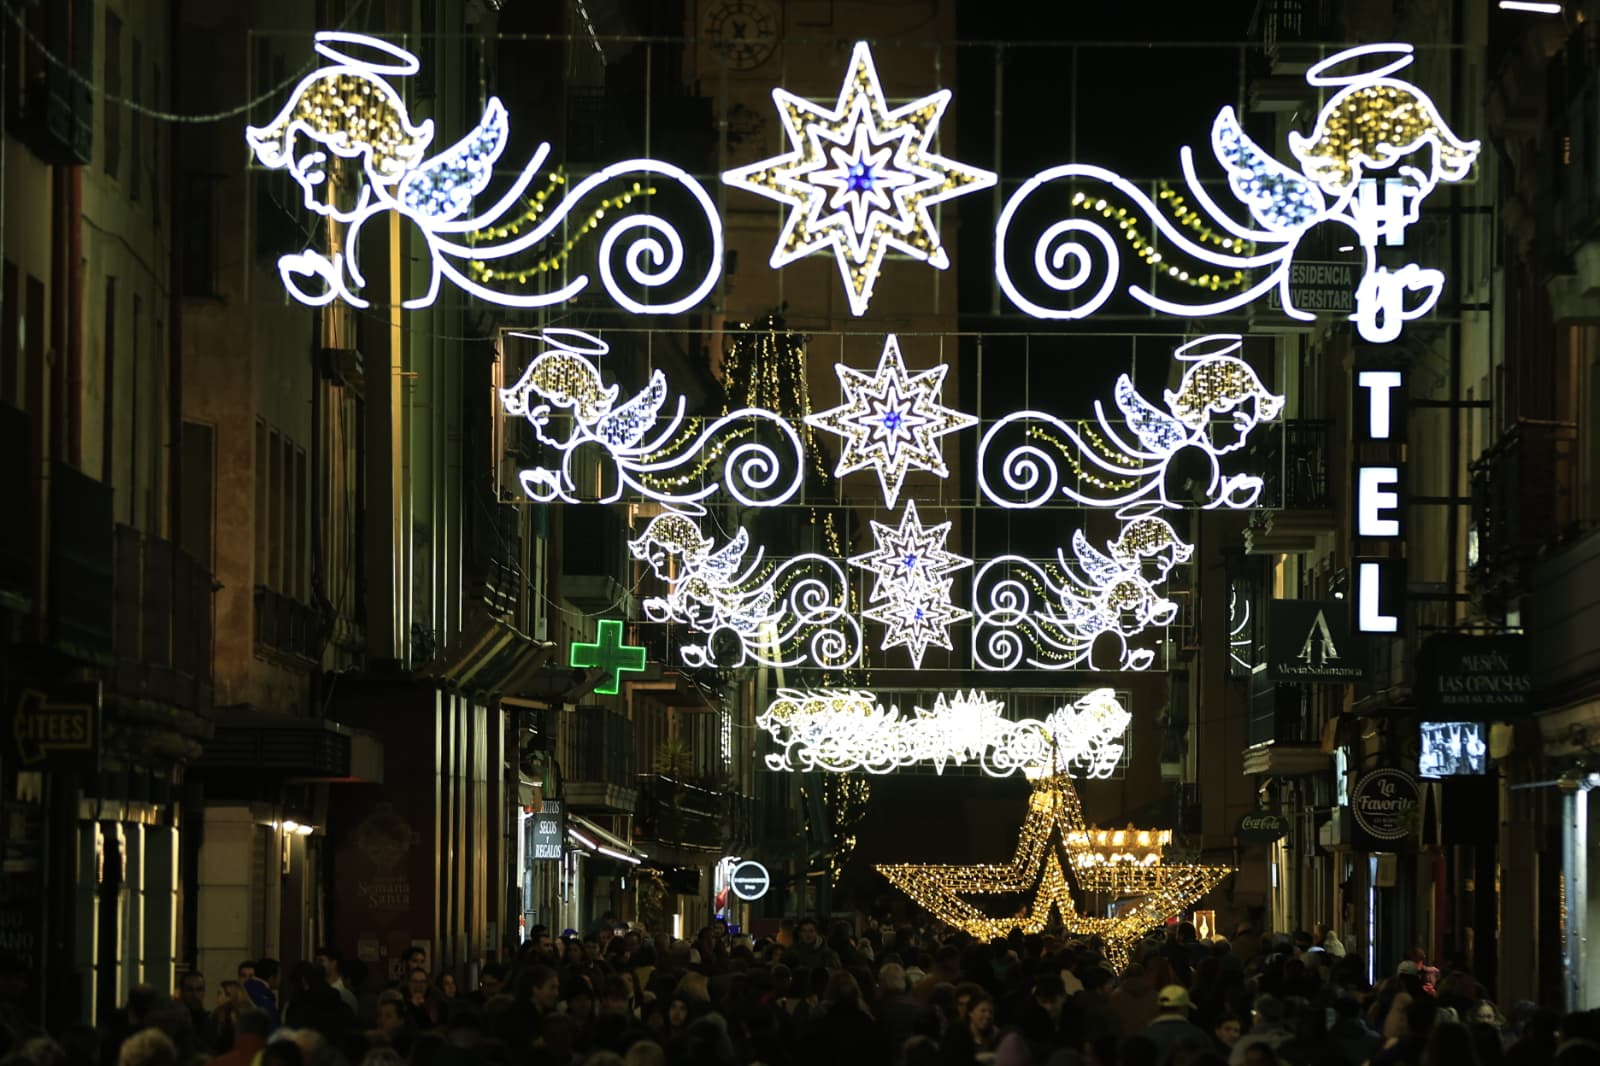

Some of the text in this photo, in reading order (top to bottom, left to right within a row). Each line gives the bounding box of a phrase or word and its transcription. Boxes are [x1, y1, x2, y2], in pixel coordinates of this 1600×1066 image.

[1290, 263, 1352, 285] ESIDENCIA
[1357, 177, 1405, 633] HOTEL
[1376, 778, 1396, 797] La
[534, 844, 562, 859] REGALOS
